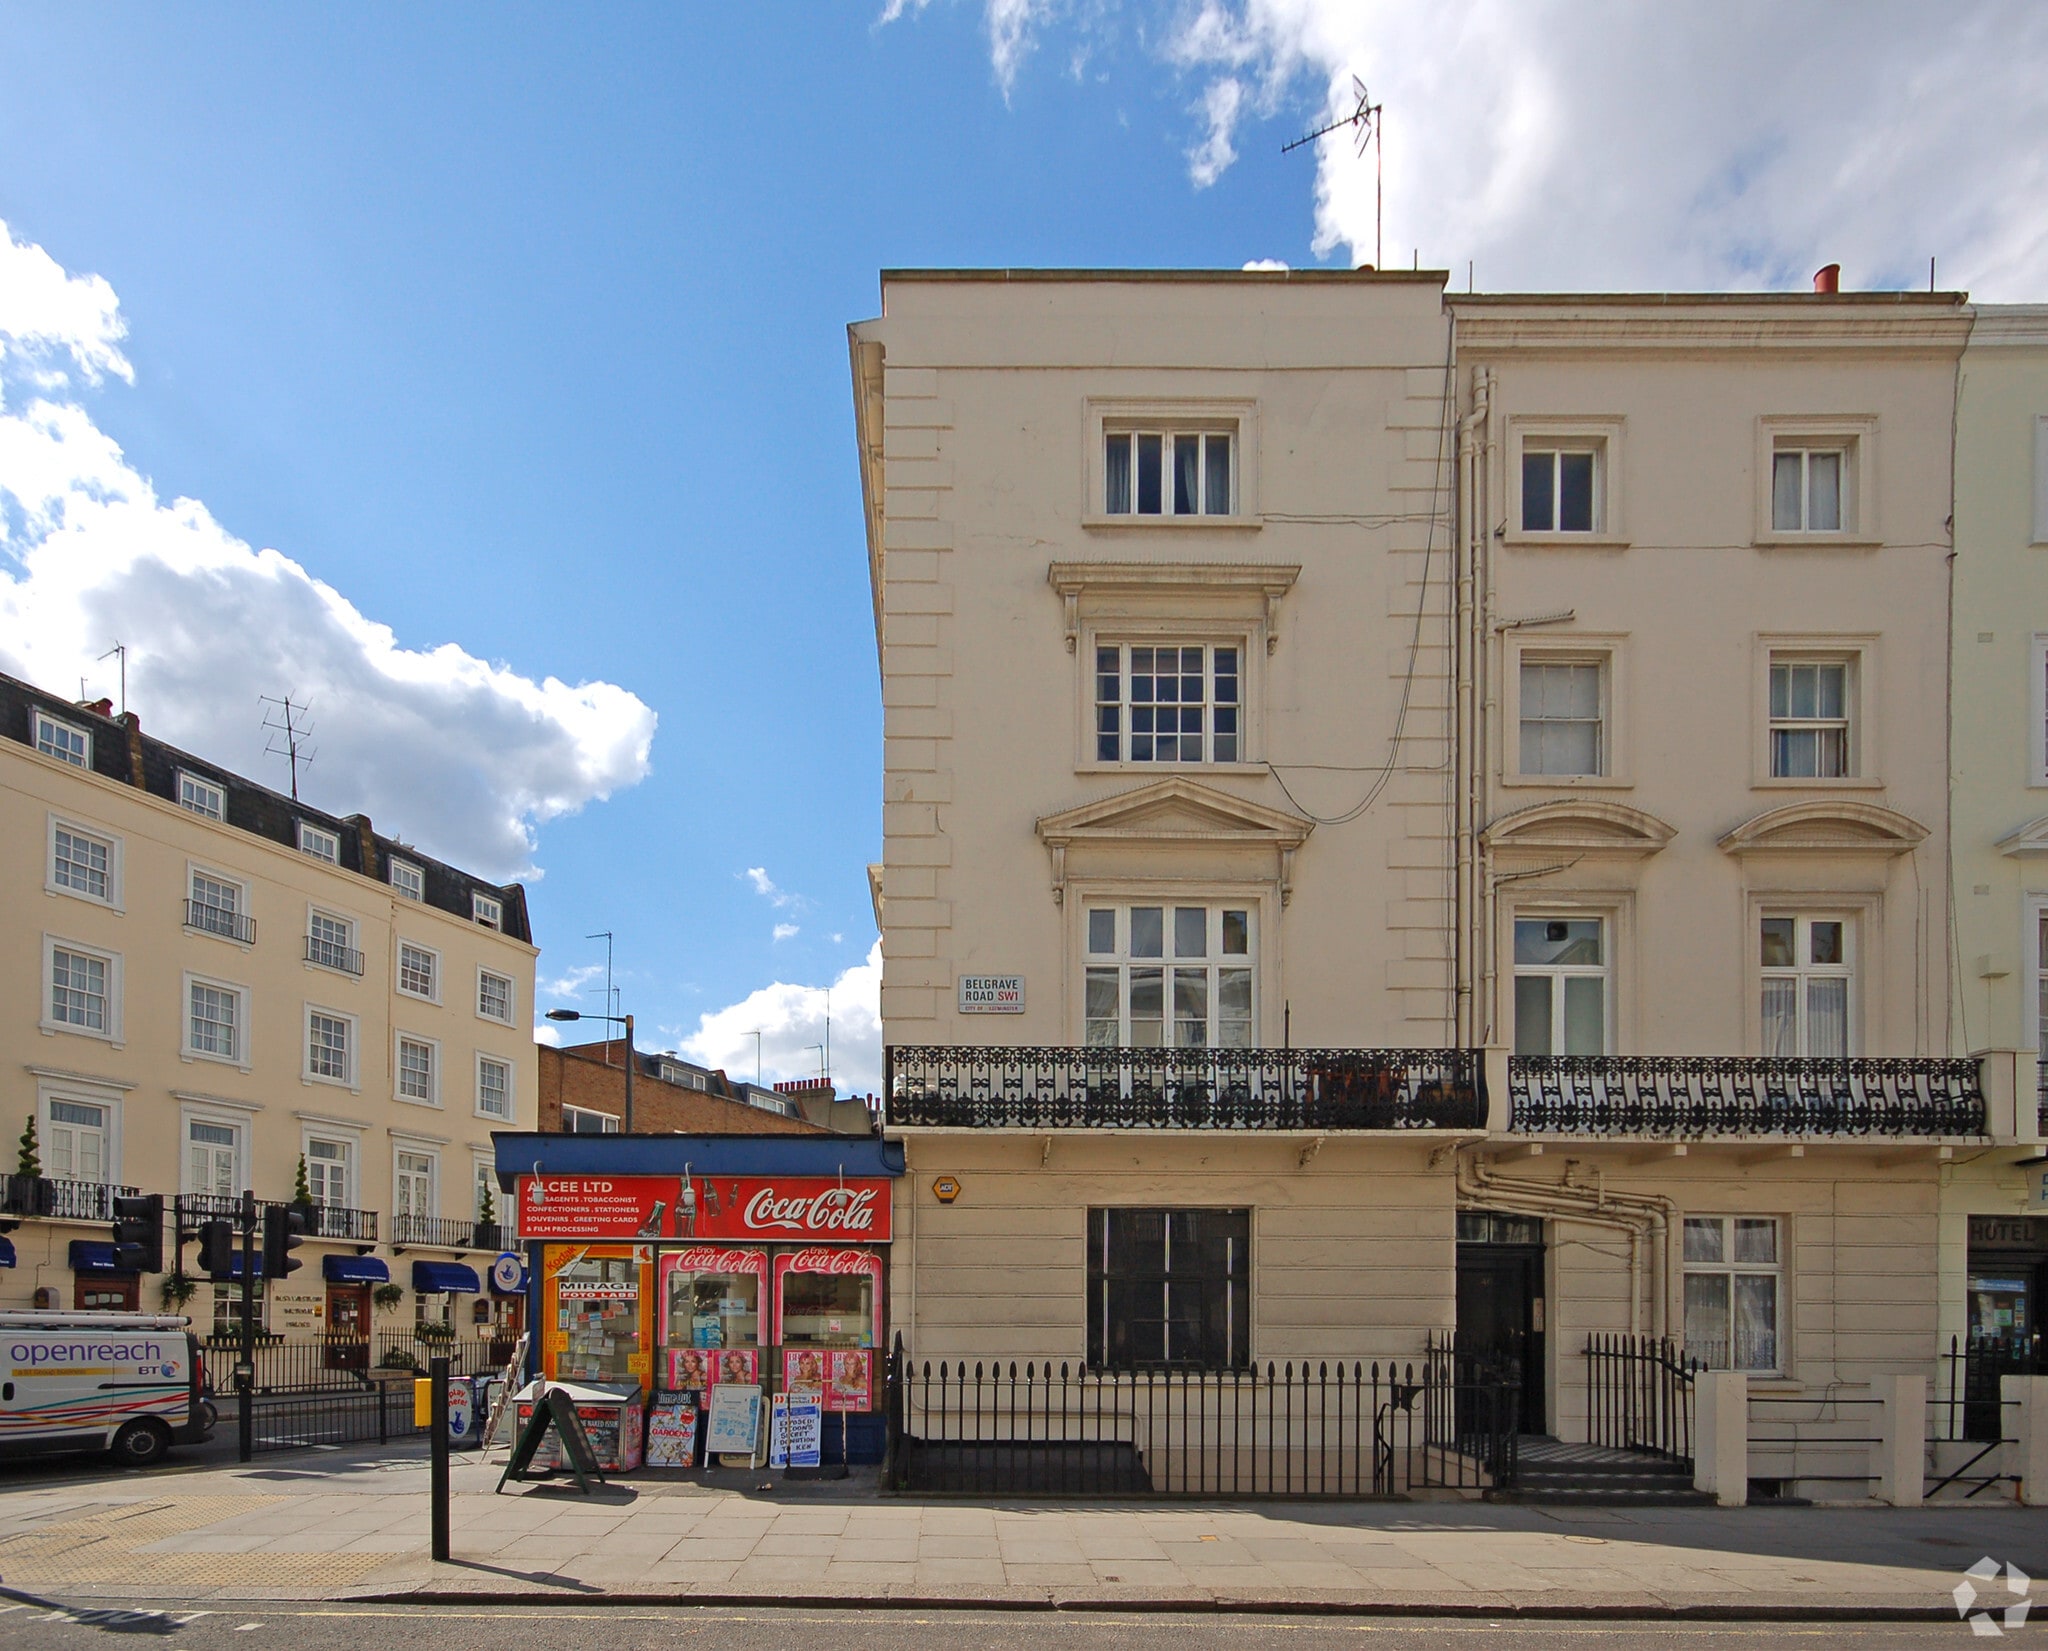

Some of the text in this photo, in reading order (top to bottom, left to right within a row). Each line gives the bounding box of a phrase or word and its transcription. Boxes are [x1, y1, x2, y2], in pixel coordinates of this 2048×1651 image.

[965, 979, 1018, 990] BELGRAVE
[965, 991, 1018, 1001] ROAD SW1
[527, 1181, 613, 1193] ALCEE LTD
[744, 1188, 878, 1230] Coca-Cola
[1971, 1223, 2035, 1241] HOTEL
[696, 1246, 716, 1256] Enjoy
[810, 1246, 829, 1255] Enjoy
[546, 1245, 576, 1271] Kodak
[676, 1249, 760, 1274] Coca-Cola
[790, 1249, 873, 1274] Coca-Cola
[11, 1341, 161, 1365] openreach
[138, 1366, 159, 1375] BT
[449, 1389, 466, 1398] play
